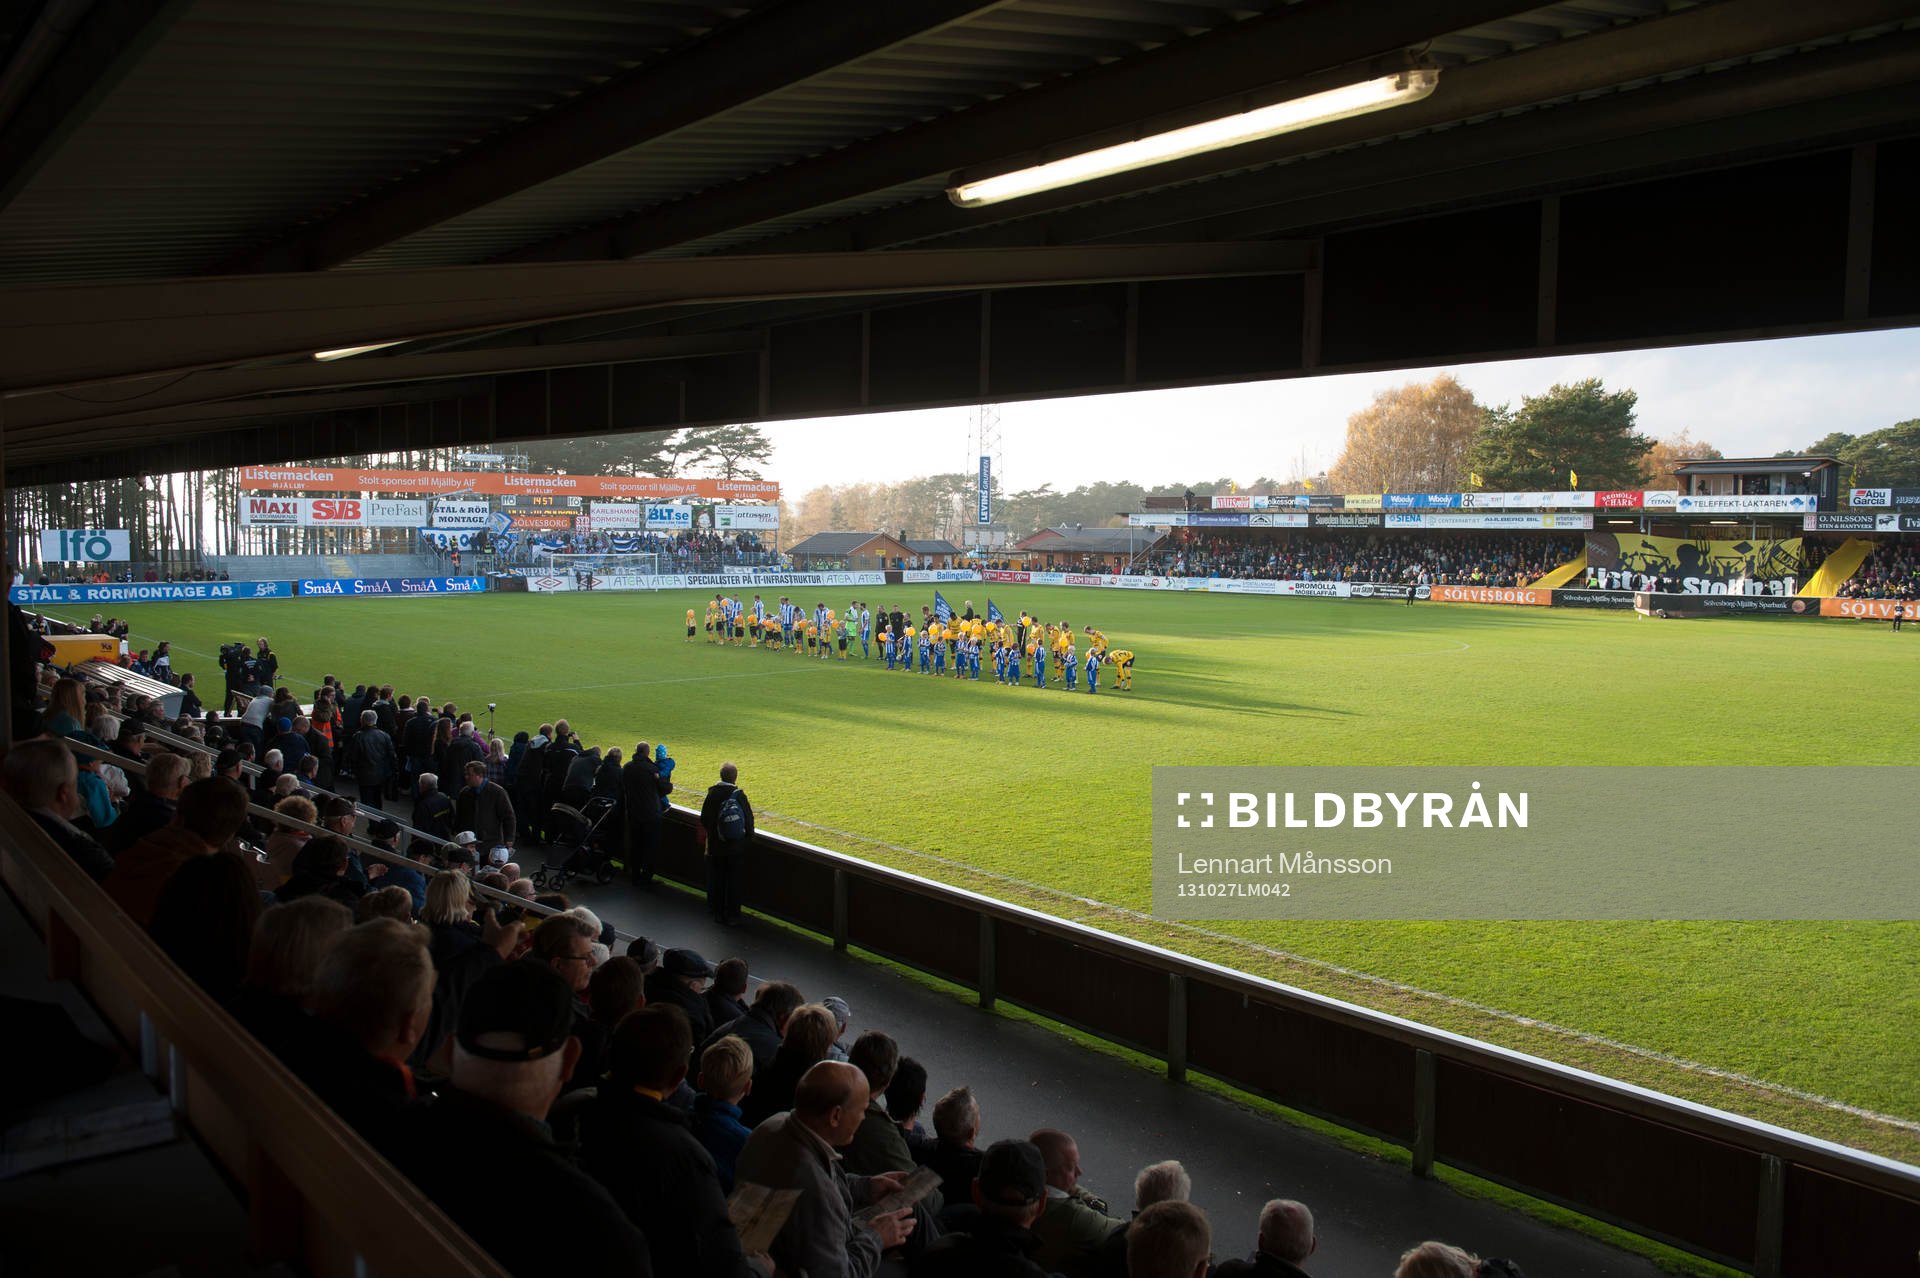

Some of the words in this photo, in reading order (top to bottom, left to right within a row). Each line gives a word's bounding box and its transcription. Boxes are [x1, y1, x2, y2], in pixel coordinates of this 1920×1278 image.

[246, 469, 333, 482] Listermacken
[358, 476, 380, 485] Stolt
[381, 478, 416, 486] sponsor
[418, 477, 429, 486] till
[431, 478, 461, 488] Mjällby
[463, 478, 477, 487] AIF
[504, 475, 577, 488] Listermacken
[716, 481, 777, 492] Listermacken
[1866, 490, 1885, 498] Abu
[250, 499, 298, 514] MAXI
[1390, 495, 1414, 507] Woody
[1428, 495, 1452, 507] Woody
[1853, 497, 1885, 505] Garcia
[371, 503, 424, 516] PreFast
[468, 505, 488, 513] RÖR
[1396, 514, 1421, 522] STENA
[687, 575, 740, 585] SPECIALISTER
[754, 574, 821, 585] IT-INFRASTRUKTUR
[936, 571, 974, 581] Ballingslöv
[304, 580, 344, 594] SmåA
[354, 580, 392, 593] SmåA
[401, 579, 437, 592] SmåA
[446, 579, 482, 591] SmåA
[18, 587, 63, 601] STÅL
[68, 589, 81, 600] &
[88, 586, 206, 600] RÖRMONTAGE
[211, 585, 233, 596] AB
[1444, 587, 1536, 603] SÖLVESBORG
[1758, 601, 1787, 609] Sparbank
